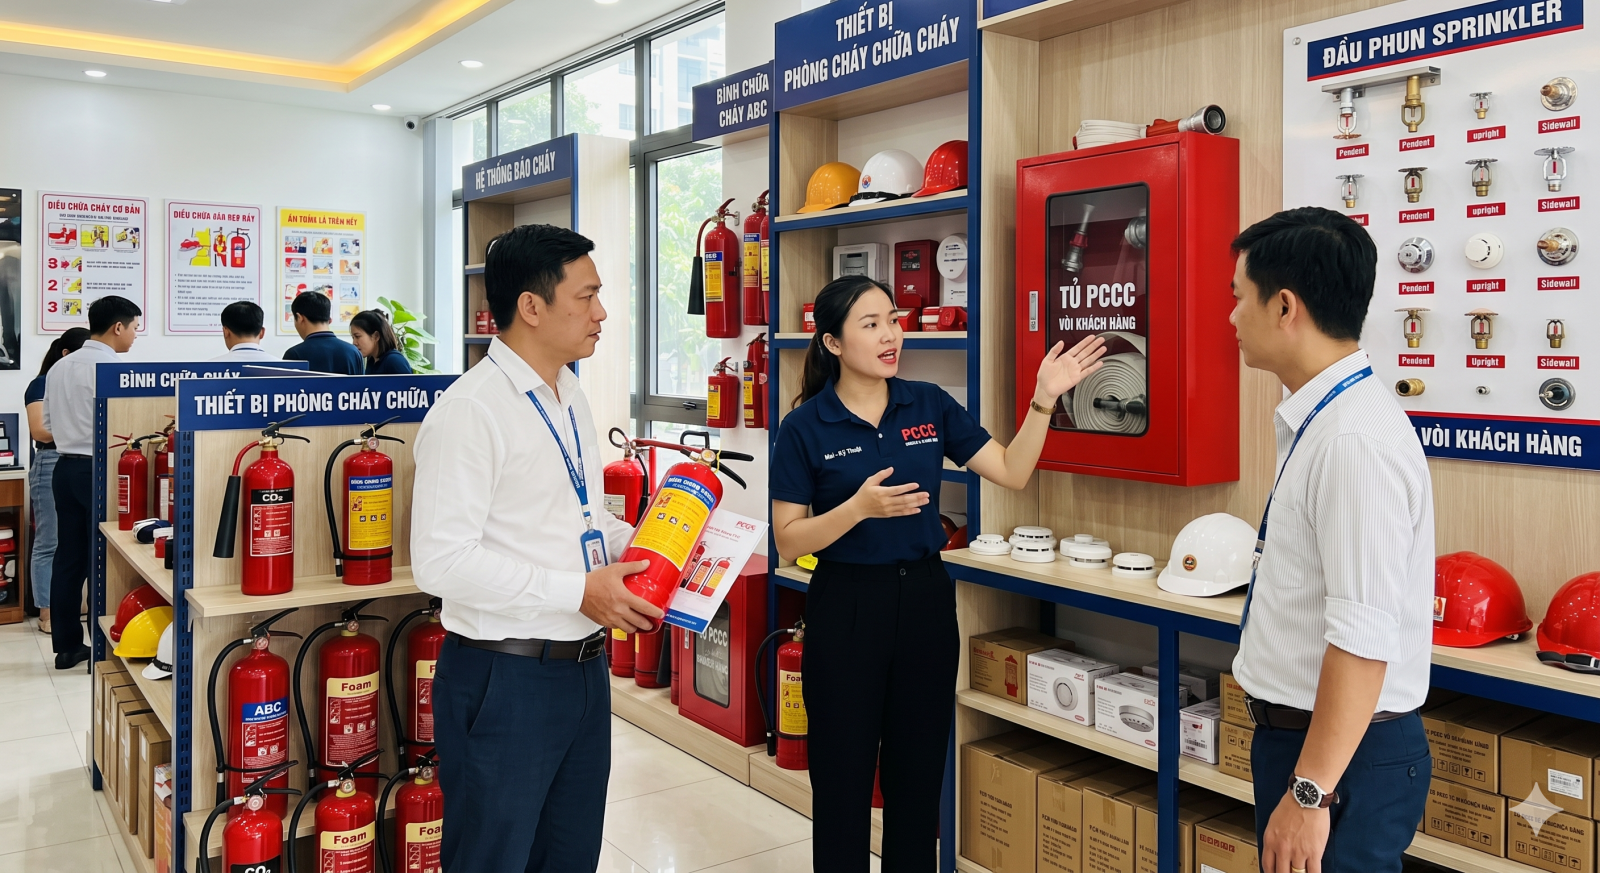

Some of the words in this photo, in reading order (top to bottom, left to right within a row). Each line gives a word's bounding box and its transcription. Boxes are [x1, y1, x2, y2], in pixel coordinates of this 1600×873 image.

[836, 1, 874, 42] THIẾT
[878, 1, 894, 32] BỊ
[1322, 36, 1362, 68] ĐẦU
[1368, 28, 1426, 60] PHUN
[1432, 0, 1562, 46] SPRINKLER
[784, 53, 828, 92] PHÒNG
[832, 44, 868, 78] CHÁY
[872, 30, 912, 64] CHỮA
[916, 14, 960, 53] CHÁY
[716, 82, 740, 106] BÌNH
[742, 72, 770, 98] CHỮA
[718, 102, 744, 128] CHÁY
[746, 99, 768, 120] ABC
[1542, 118, 1576, 131] Sidewall
[1472, 129, 1500, 141] upright
[1402, 138, 1430, 150] Pendent
[1339, 146, 1366, 156] Pendent
[475, 167, 486, 192] HỆ
[486, 159, 512, 187] THỐNG
[514, 155, 531, 180] BÁO
[532, 148, 556, 176] CHÁY
[1542, 199, 1576, 210] Sidewall
[1402, 211, 1430, 221] Pendent
[1472, 206, 1499, 216] upright
[48, 258, 58, 269] 3
[48, 280, 58, 291] 2
[1402, 284, 1430, 292] Pendent
[1472, 282, 1500, 292] upright
[1541, 278, 1576, 288] Sidewall
[1060, 276, 1082, 309] TỦ
[1086, 282, 1136, 308] PCCC
[48, 301, 58, 312] 3
[1058, 314, 1074, 331] VÒI
[1075, 314, 1107, 331] KHÁCH
[1109, 312, 1136, 330] HÀNG
[1402, 356, 1430, 366] Pendent
[1472, 358, 1500, 368] Upright
[1540, 358, 1576, 368] Sidewall
[120, 370, 156, 388] BÌNH
[194, 388, 245, 416] THIẾT
[250, 394, 268, 418] BỊ
[274, 388, 333, 413] PHÒNG
[338, 388, 382, 412] CHÁY
[386, 386, 429, 409] CHỮA
[901, 424, 937, 441] PCCC
[1421, 424, 1450, 448] VÒI
[1456, 426, 1520, 453] KHÁCH
[1526, 430, 1582, 457] HÀNG
[708, 626, 728, 647] PCCC
[786, 674, 802, 682] Foa
[341, 680, 372, 692] Foam
[254, 702, 282, 716] ABC
[334, 832, 367, 845] Foam
